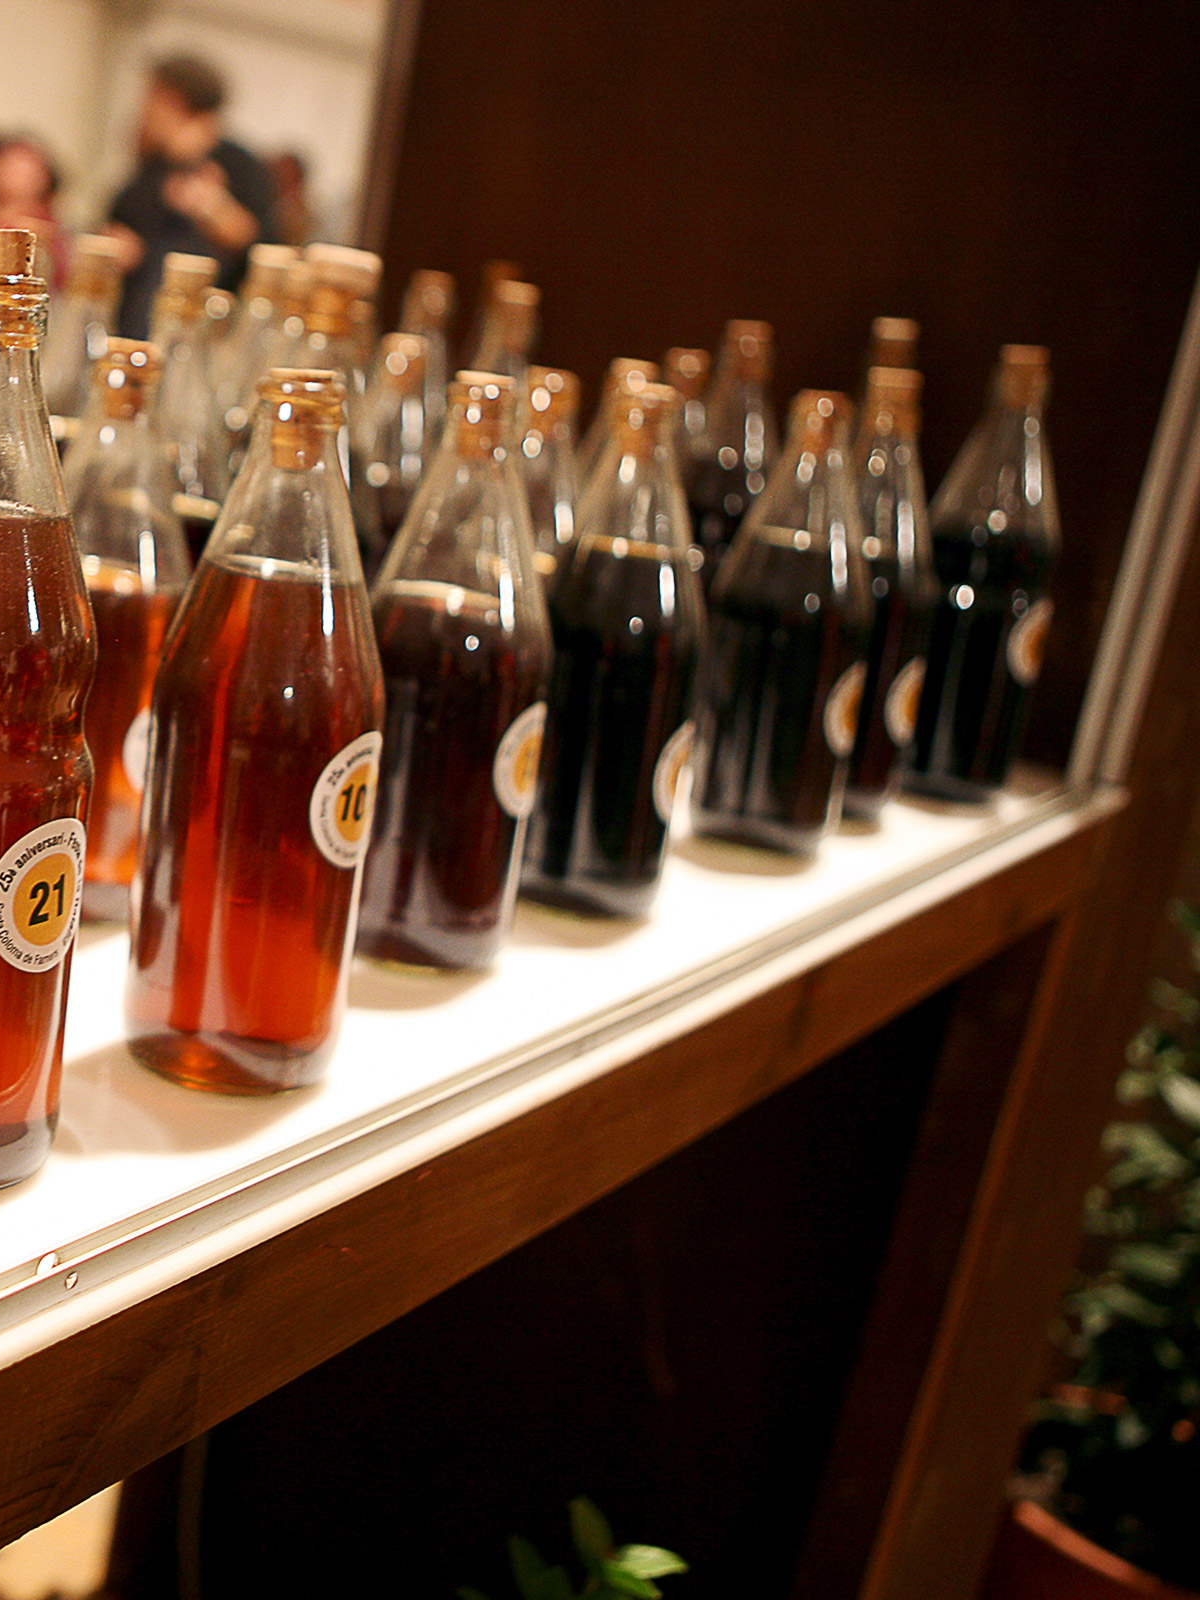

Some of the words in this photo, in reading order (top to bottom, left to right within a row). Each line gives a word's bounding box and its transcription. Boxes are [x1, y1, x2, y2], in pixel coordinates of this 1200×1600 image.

[341, 784, 367, 821] 10
[14, 832, 65, 869] aniversari
[28, 873, 66, 927] 21
[22, 953, 34, 965] de
